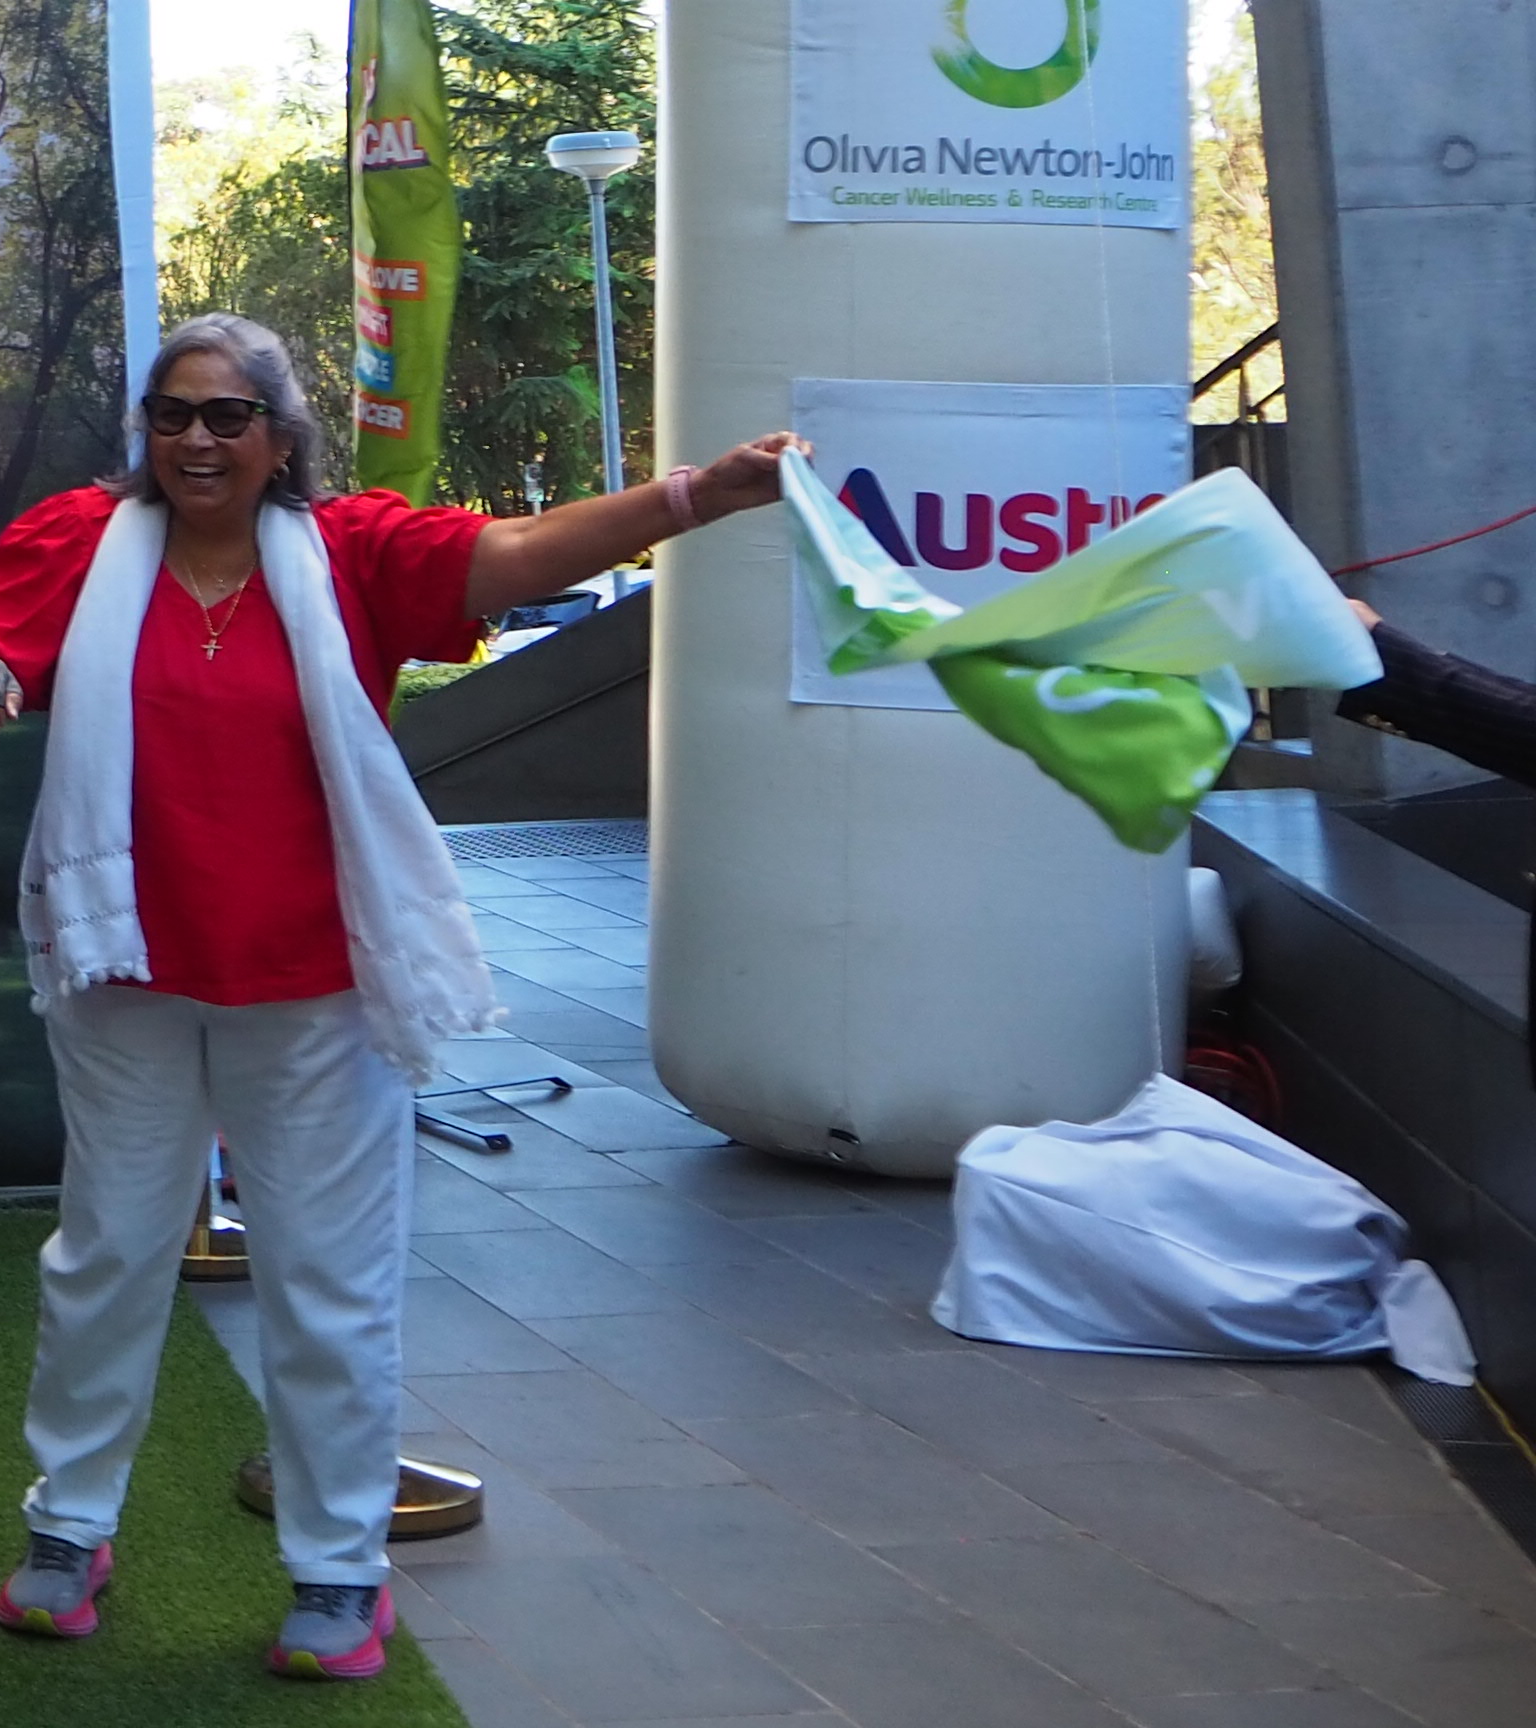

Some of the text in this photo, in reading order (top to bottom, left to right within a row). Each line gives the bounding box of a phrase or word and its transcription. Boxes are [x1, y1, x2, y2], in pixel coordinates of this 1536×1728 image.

[804, 134, 1174, 182] Olivia Newton-John
[832, 186, 900, 207] Cancer
[907, 187, 997, 208] Wellness
[1007, 188, 1023, 207] &
[838, 467, 1168, 573] Aust
